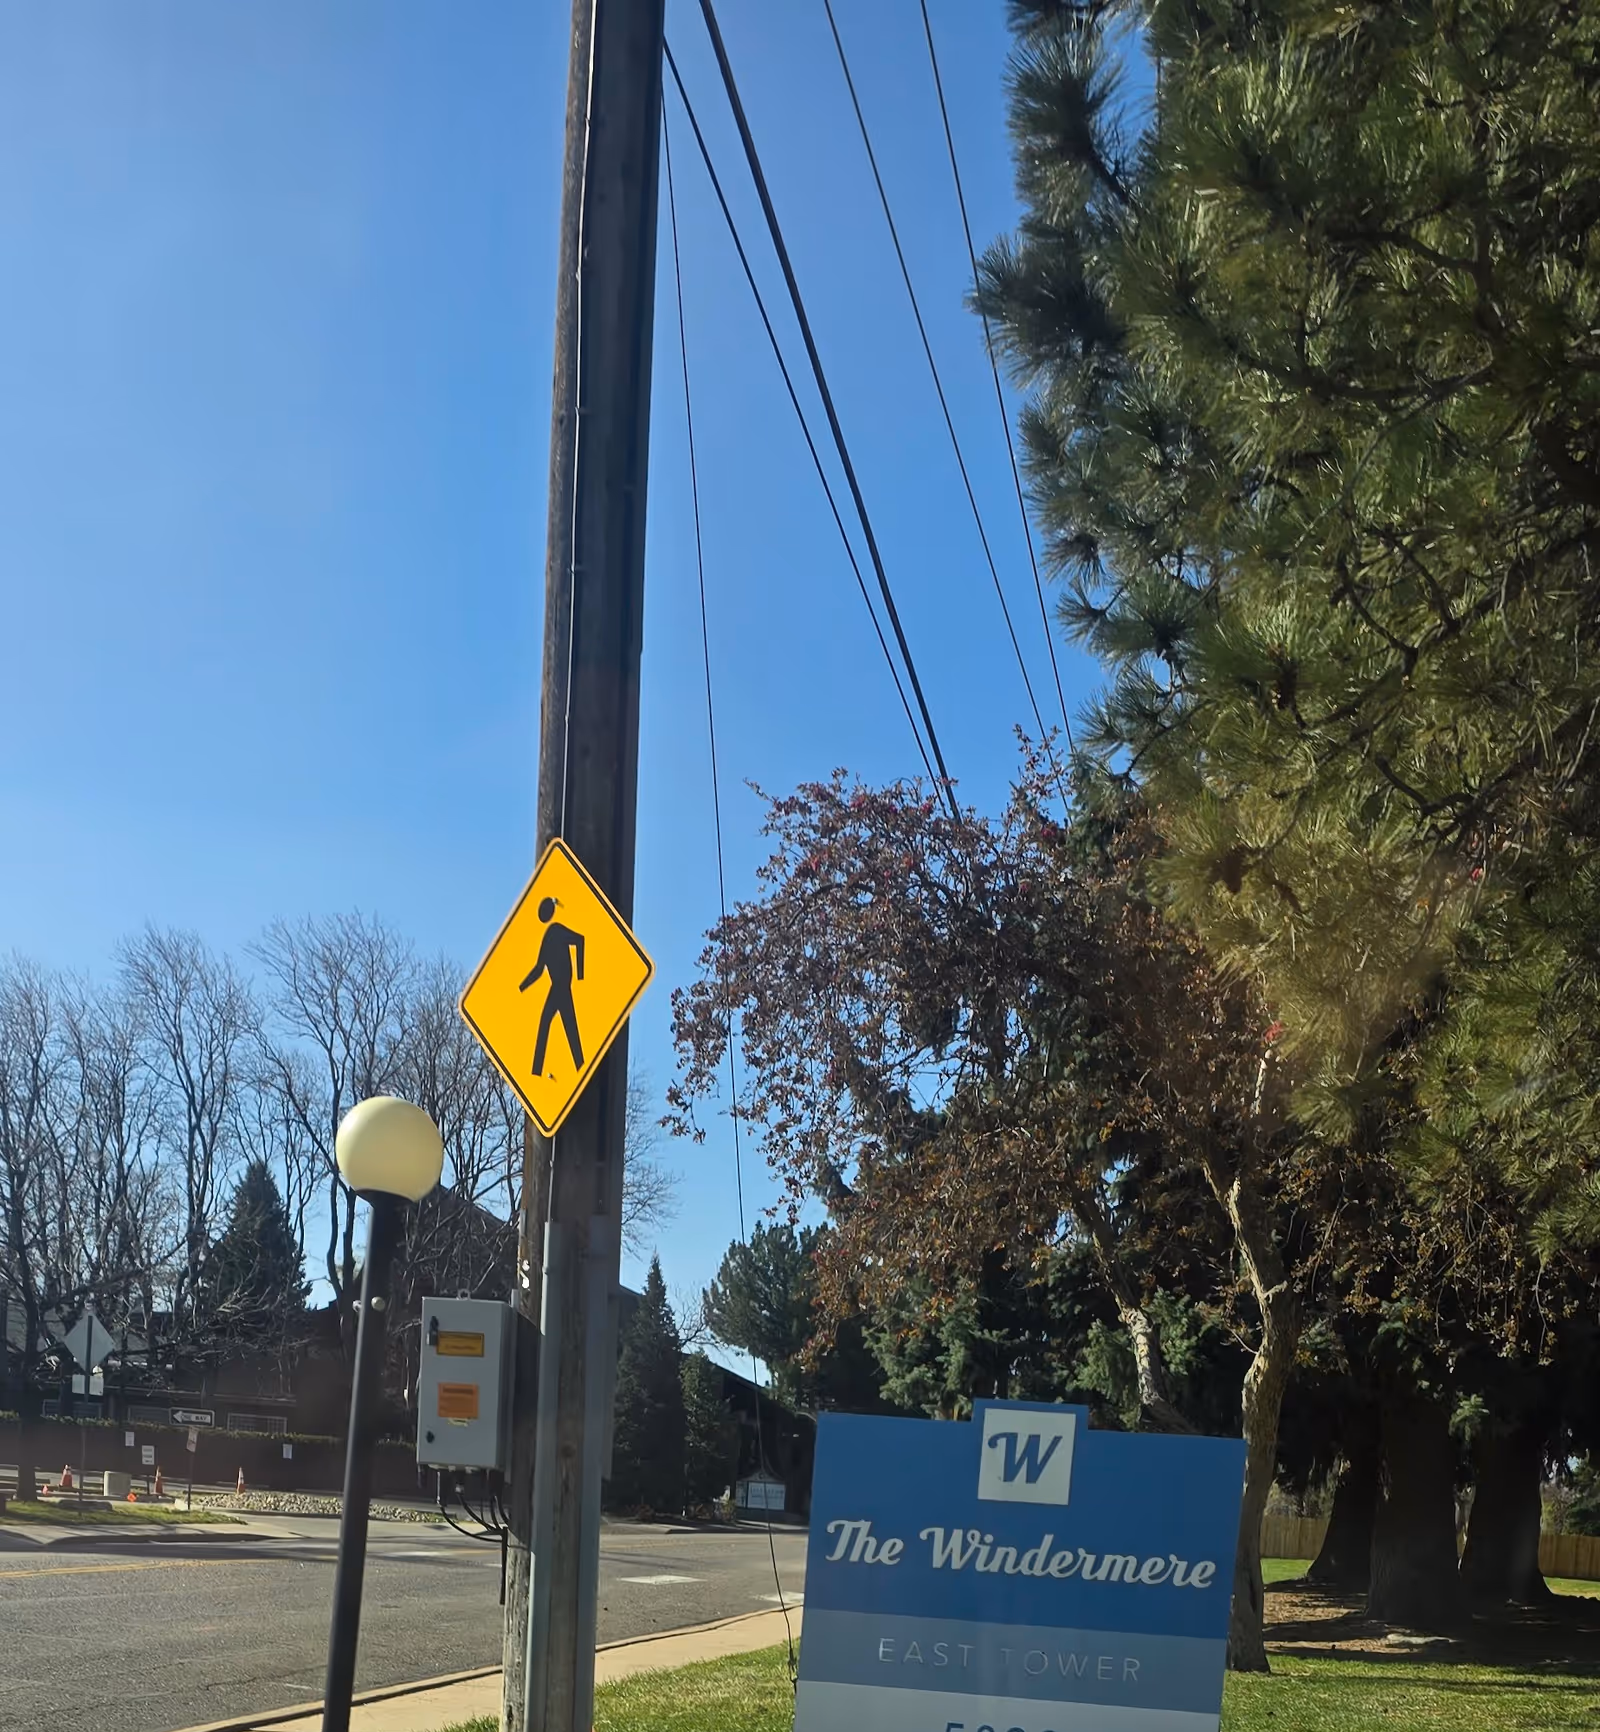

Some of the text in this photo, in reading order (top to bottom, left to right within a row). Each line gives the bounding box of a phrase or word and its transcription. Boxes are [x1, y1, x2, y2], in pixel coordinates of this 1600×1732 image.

[987, 1431, 1063, 1484] W
[825, 1519, 1217, 1589] The Windermere
[878, 1637, 1142, 1682] EAST TOWER
